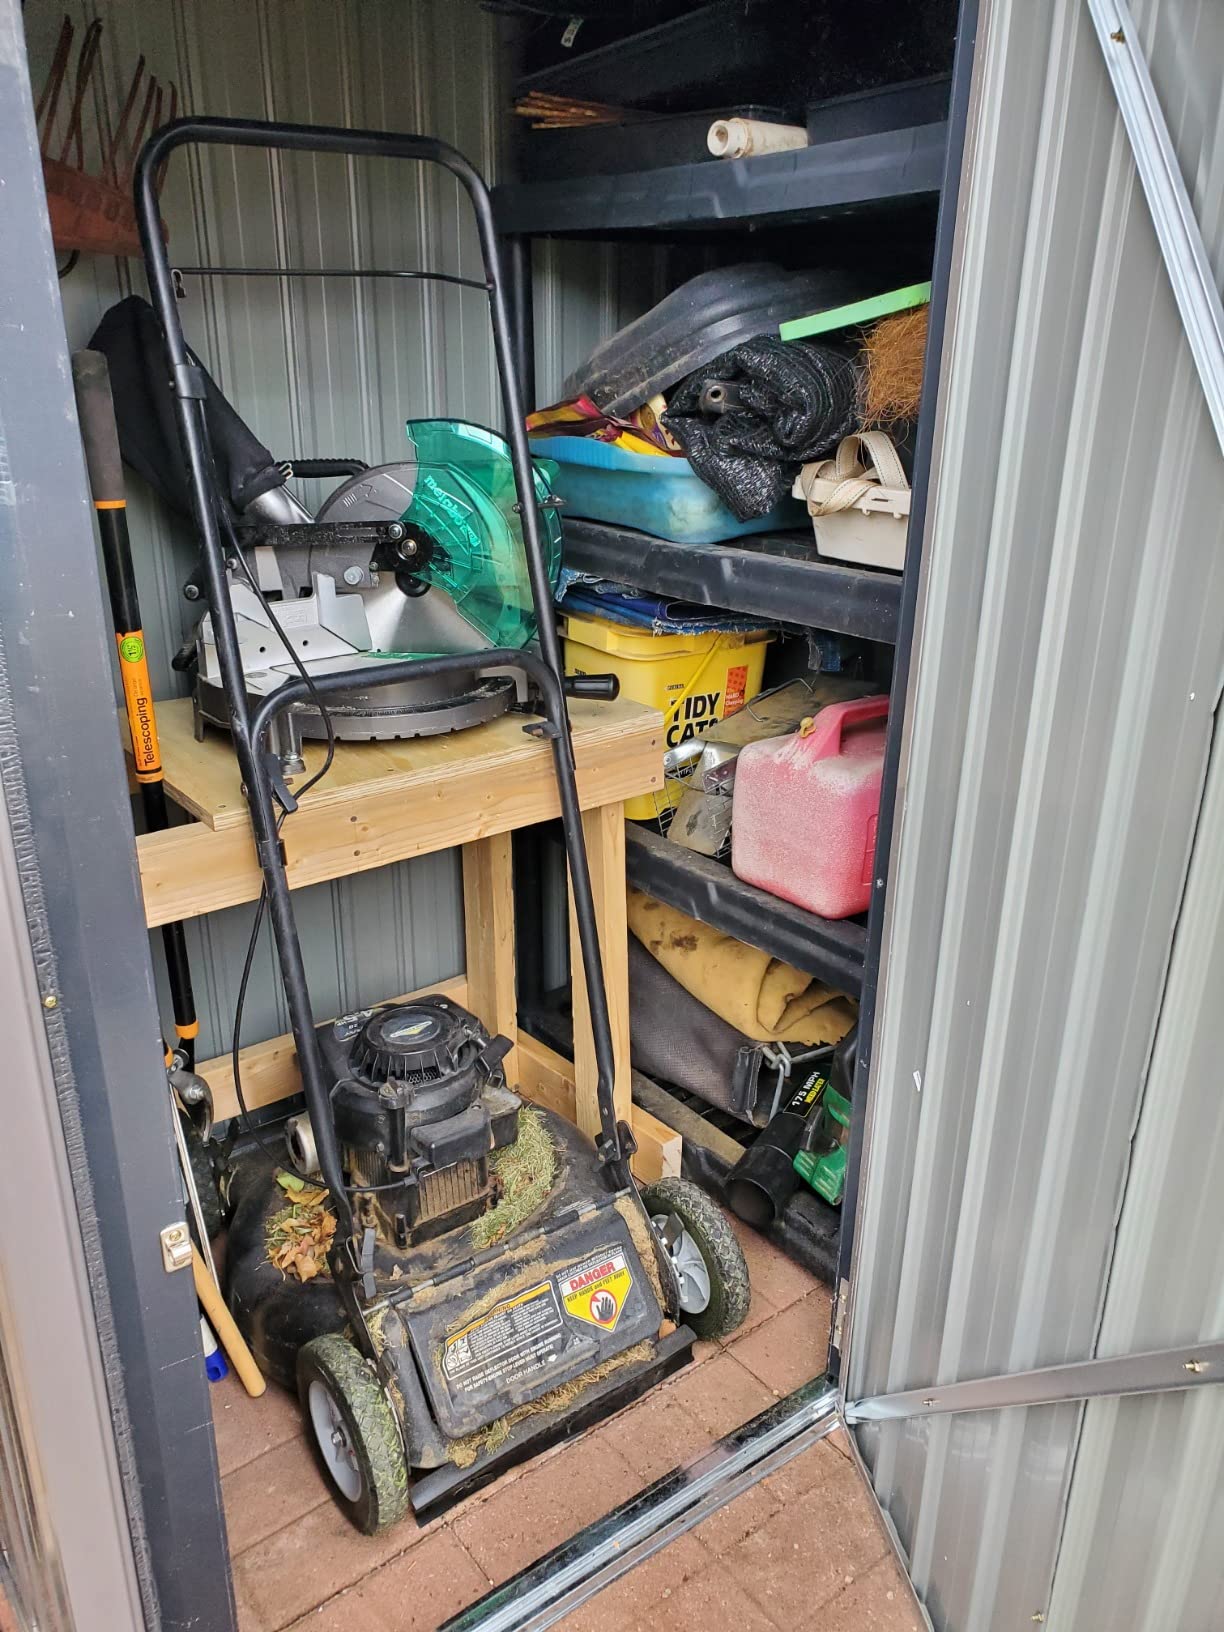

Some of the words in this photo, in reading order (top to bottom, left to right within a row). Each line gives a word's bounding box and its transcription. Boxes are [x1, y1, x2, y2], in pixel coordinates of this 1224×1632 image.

[671, 692, 720, 722] TIDY
[136, 697, 155, 767] Telescoping
[792, 1090, 807, 1106] 175
[803, 1071, 820, 1090] MPH
[567, 1294, 577, 1302] KEEP
[579, 1286, 593, 1296] HANDS
[603, 1277, 612, 1285] FEET
[614, 1271, 624, 1279] AWAY
[570, 1262, 615, 1291] DANGER
[463, 1377, 472, 1386] NOT
[508, 1354, 519, 1363] DOOR
[465, 1384, 473, 1393] FOR
[513, 1358, 525, 1368] LEVER
[506, 1371, 523, 1384] DOOR
[523, 1359, 545, 1375] HANDLE
